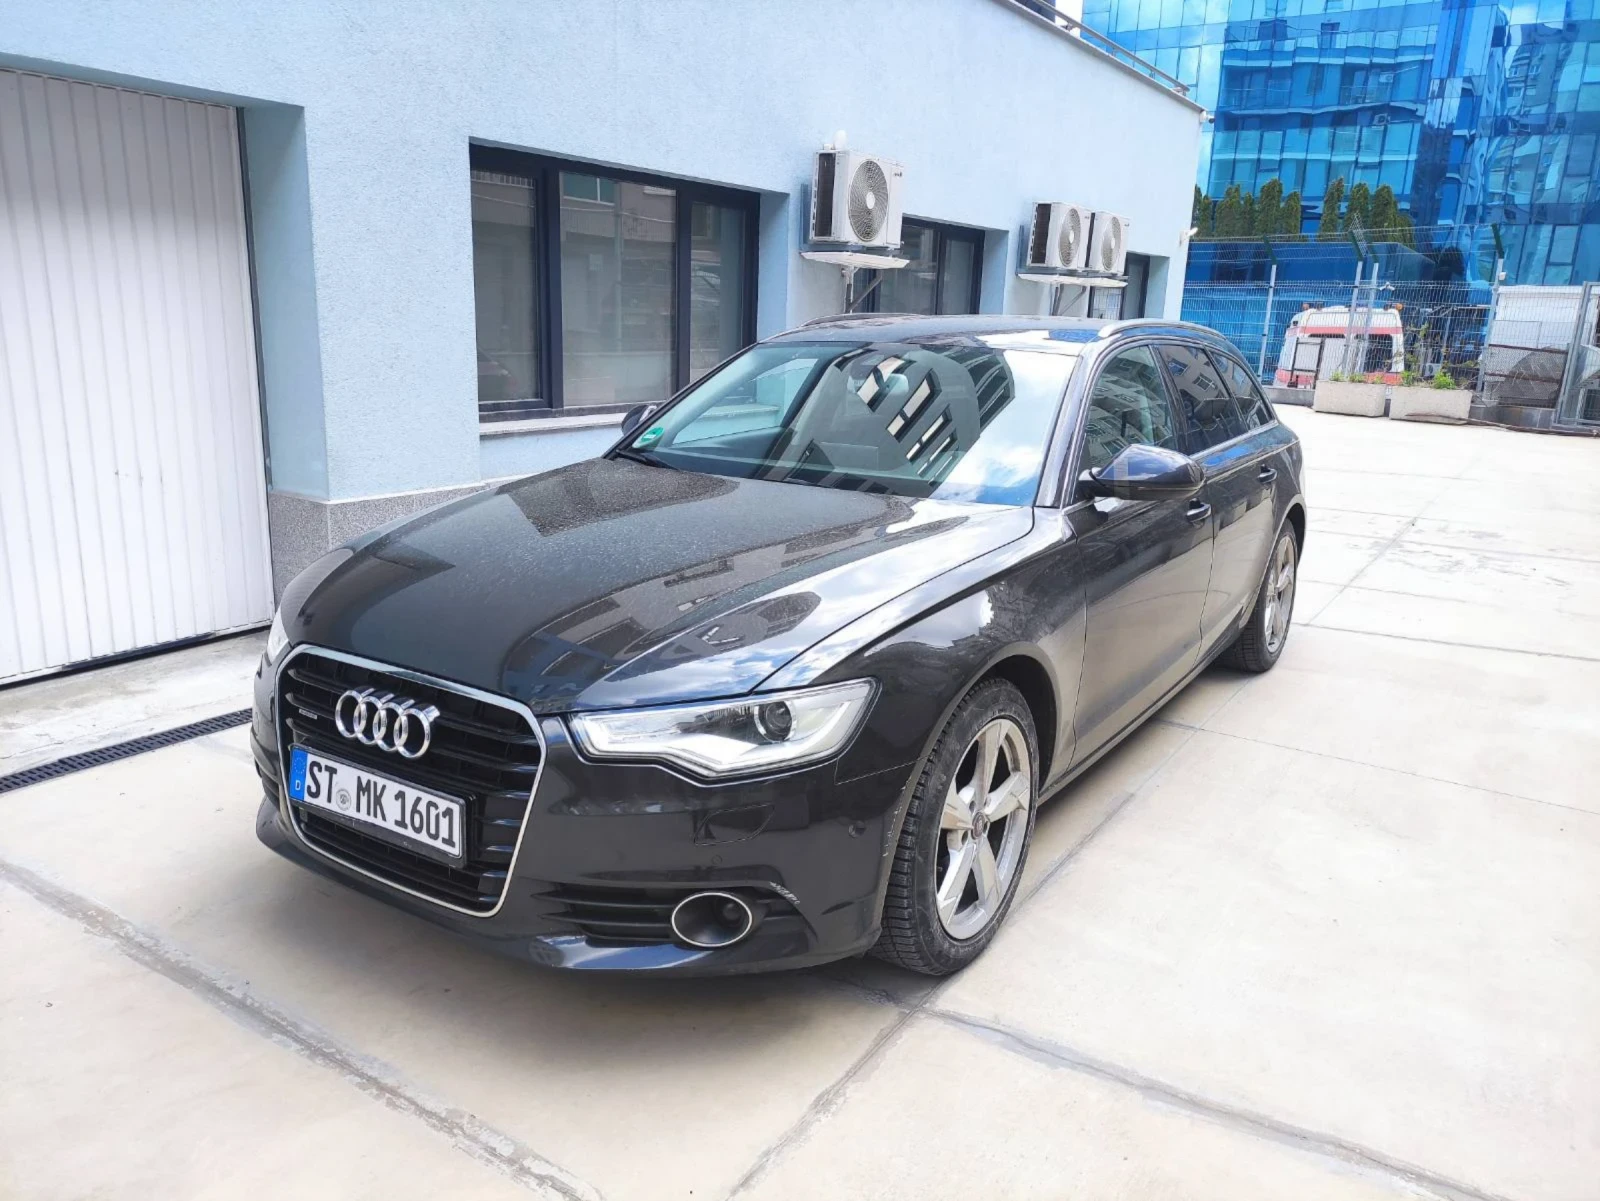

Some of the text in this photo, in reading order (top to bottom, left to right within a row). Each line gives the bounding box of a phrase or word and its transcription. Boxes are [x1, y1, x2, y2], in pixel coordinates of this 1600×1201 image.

[295, 780, 301, 791] D
[306, 760, 456, 848] ST MK 1601
